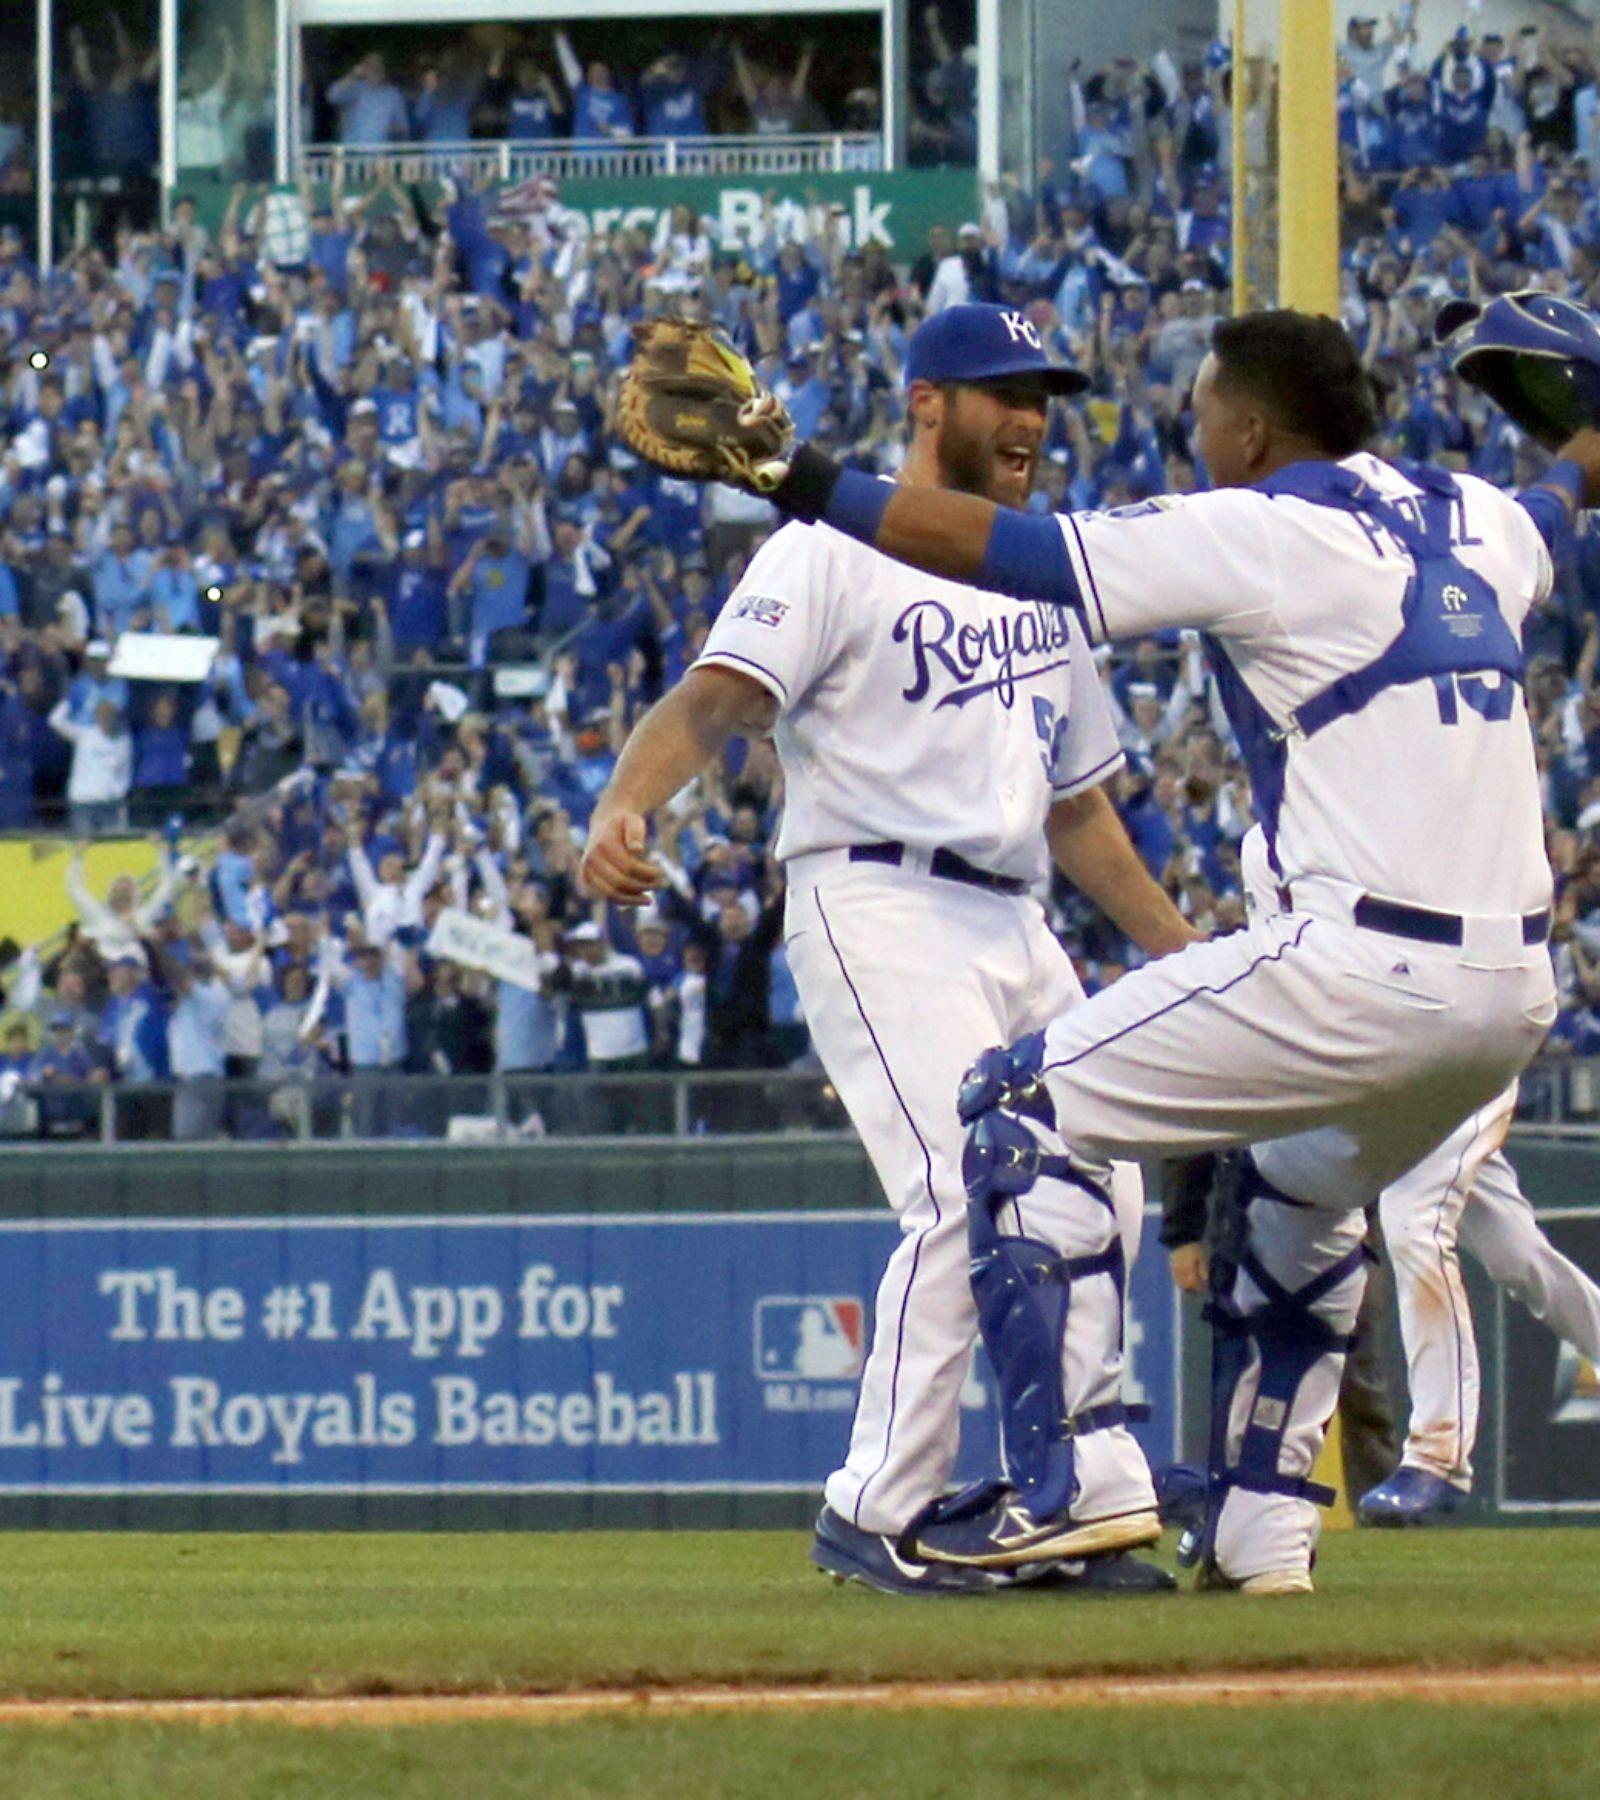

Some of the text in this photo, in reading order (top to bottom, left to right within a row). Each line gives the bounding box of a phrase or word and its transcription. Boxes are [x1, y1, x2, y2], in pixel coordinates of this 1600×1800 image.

[999, 311, 1042, 349] KC
[892, 600, 1071, 710] Royals
[99, 1262, 625, 1358] The #1 App for
[0, 1370, 721, 1465] Live Royals Baseball
